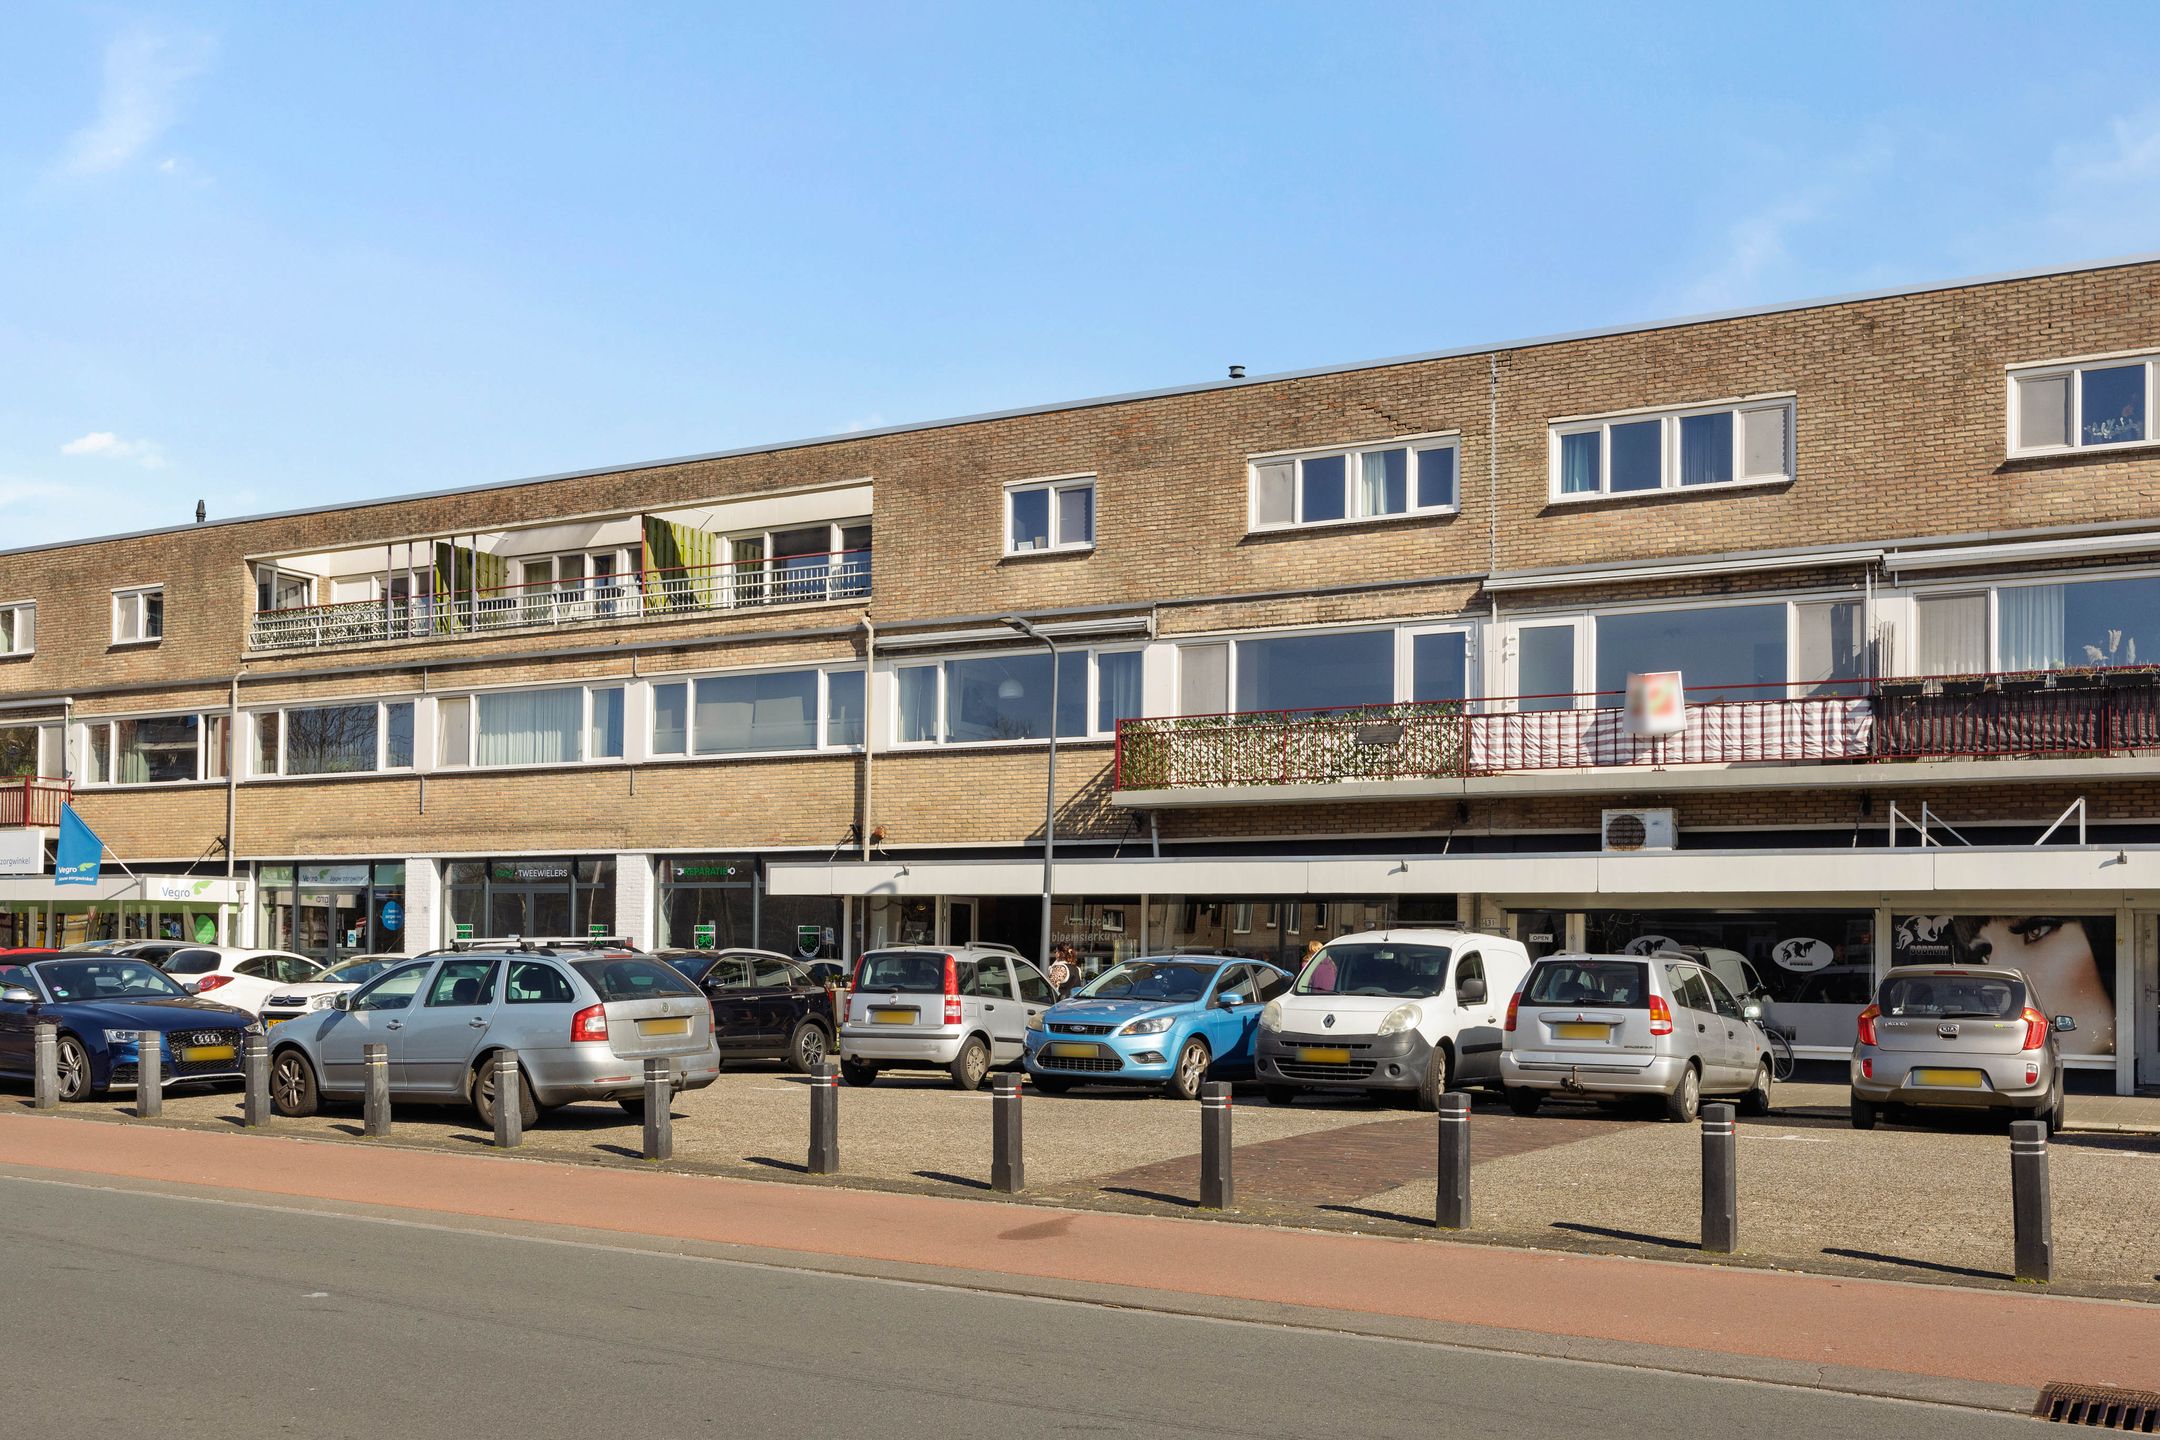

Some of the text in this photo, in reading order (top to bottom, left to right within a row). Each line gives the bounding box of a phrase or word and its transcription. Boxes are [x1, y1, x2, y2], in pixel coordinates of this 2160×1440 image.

[0, 857, 31, 867] zorgwinkel
[518, 869, 568, 877] TWEEWIELERS
[684, 867, 728, 876] REPARATIE
[162, 887, 190, 899] Vegro
[1051, 930, 1128, 942] bloemsierkunst
